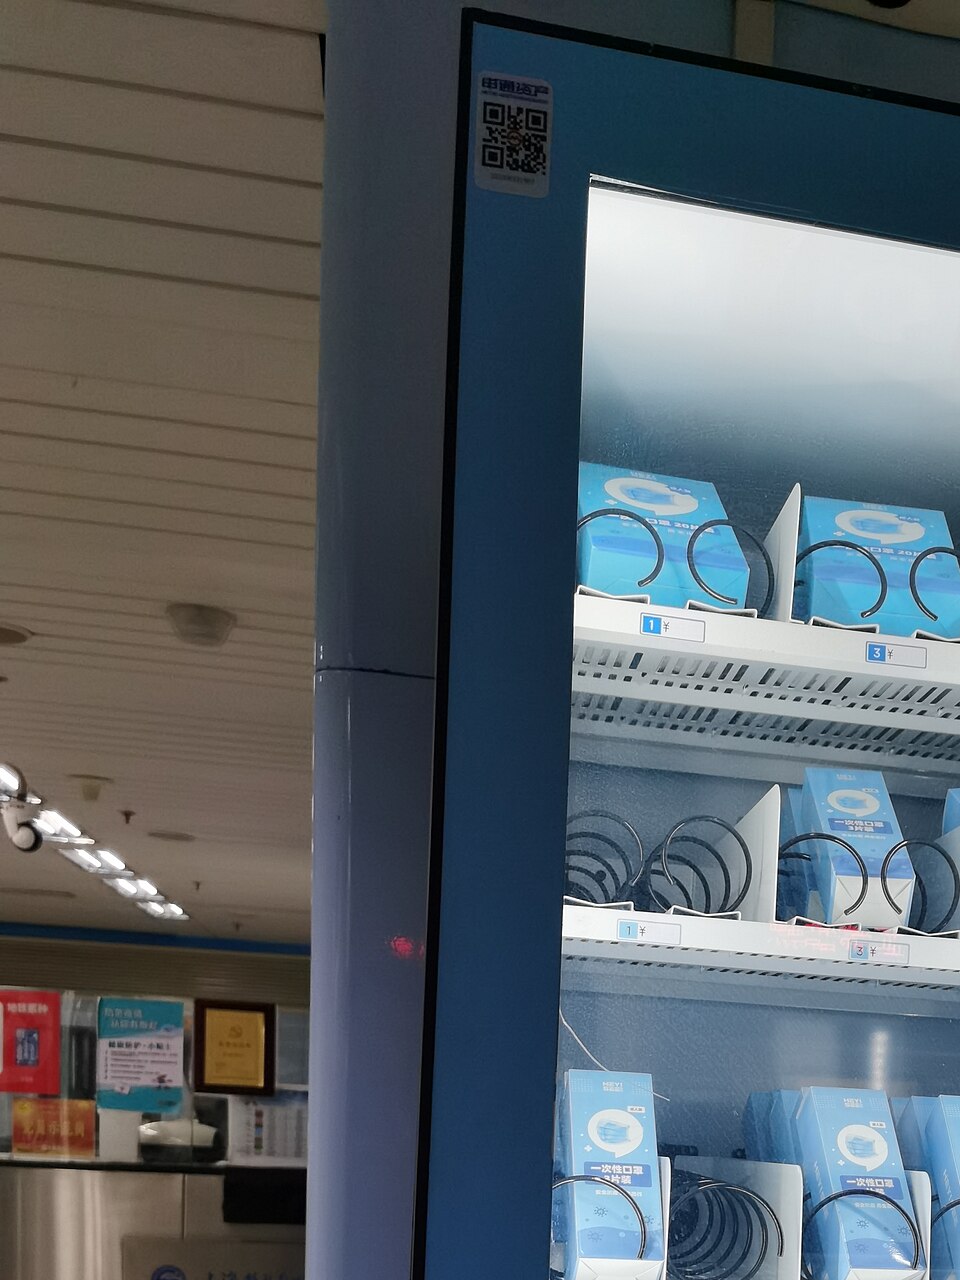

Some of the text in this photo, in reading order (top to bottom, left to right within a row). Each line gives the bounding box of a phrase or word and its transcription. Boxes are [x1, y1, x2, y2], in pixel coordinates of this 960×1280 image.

[648, 620, 654, 631] 1
[873, 648, 881, 658] 3
[626, 925, 632, 936] 1
[856, 946, 864, 956] 3
[590, 1164, 643, 1175] 一次性口罩
[846, 1177, 894, 1187] 一次性口罩
